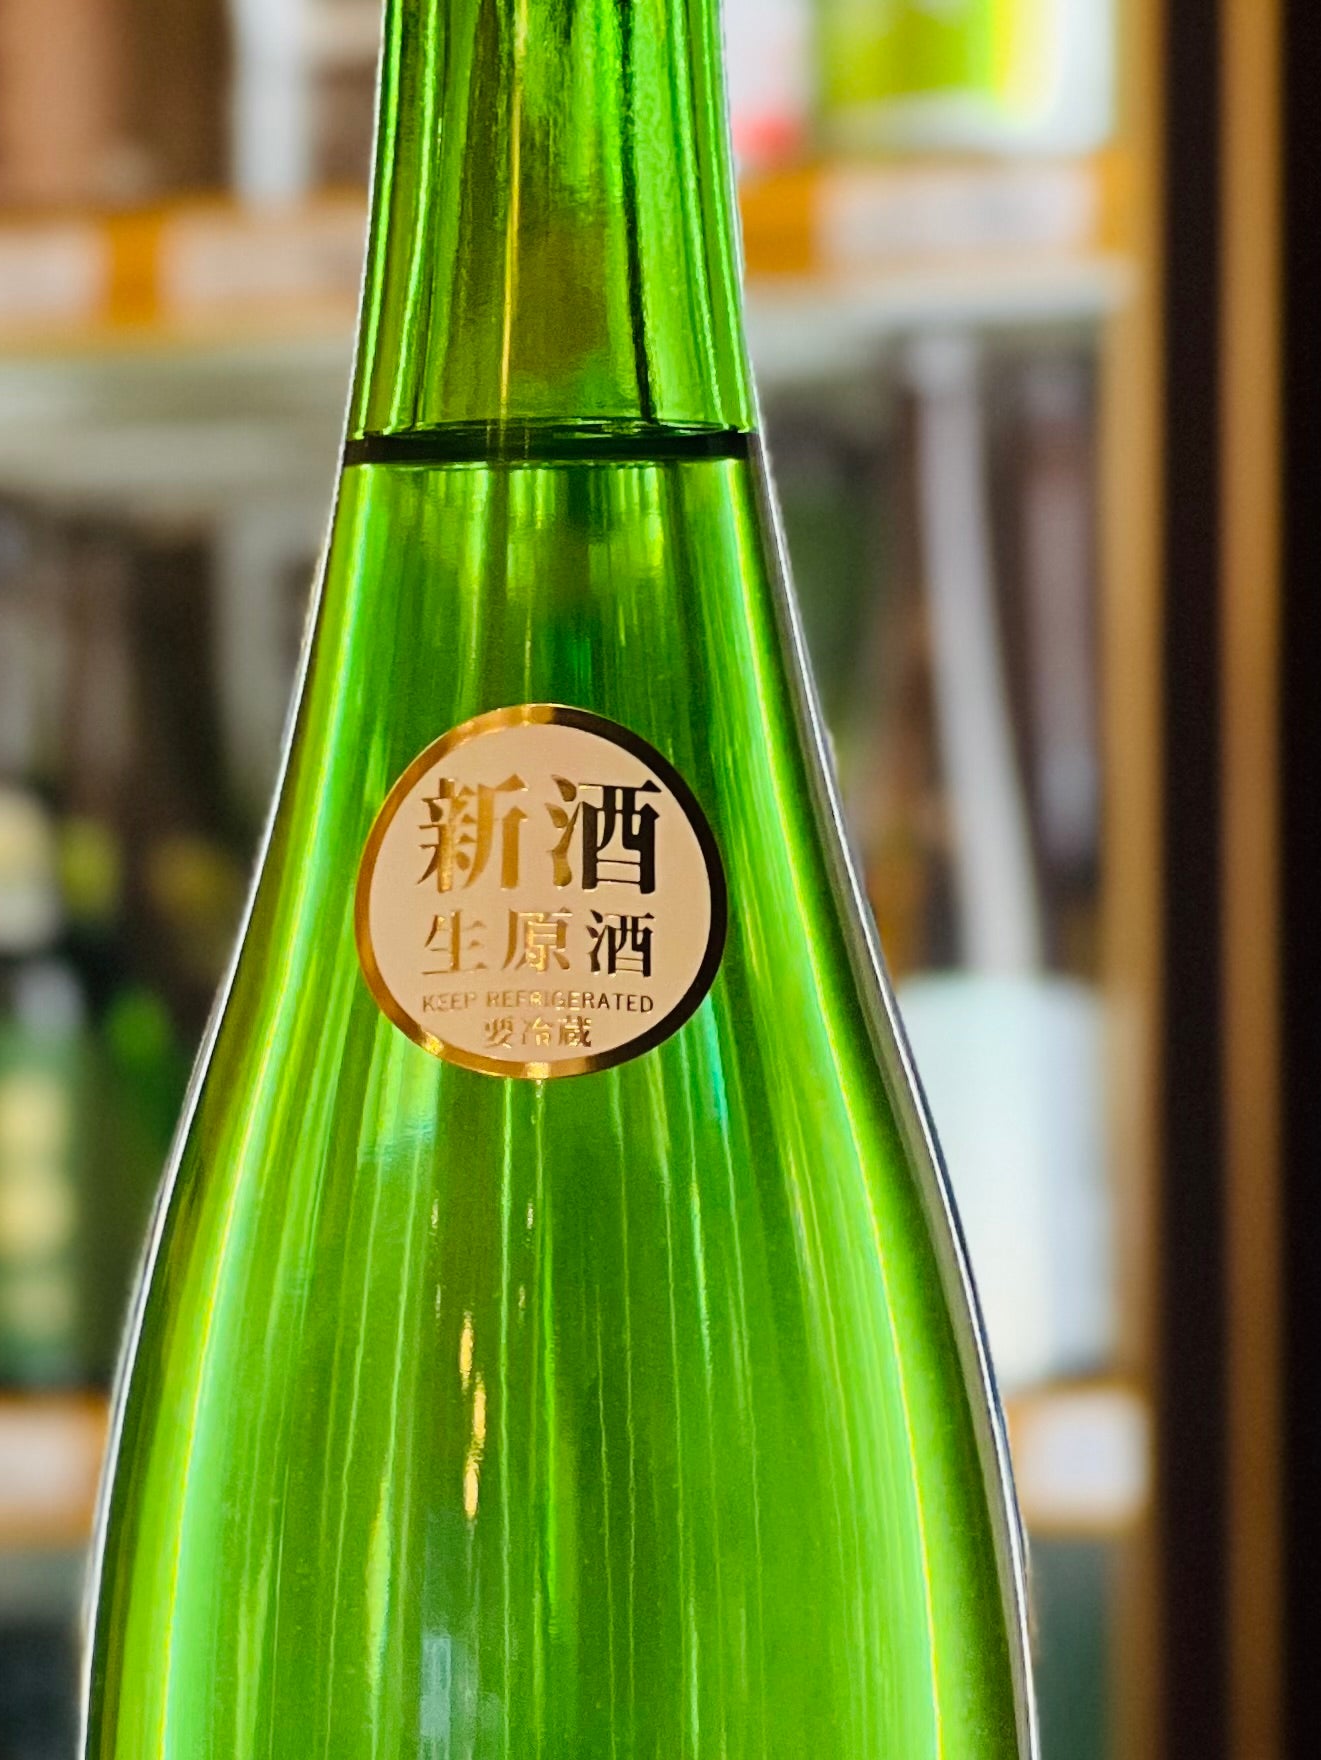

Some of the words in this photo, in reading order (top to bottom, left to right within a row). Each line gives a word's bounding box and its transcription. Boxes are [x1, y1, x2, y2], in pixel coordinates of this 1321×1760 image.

[417, 773, 663, 894] 新酒
[421, 908, 656, 979] 生原酒
[421, 991, 477, 1013] KEEP
[486, 990, 654, 1014] REFRIGERATED
[484, 1015, 592, 1049] 要冷蔵
